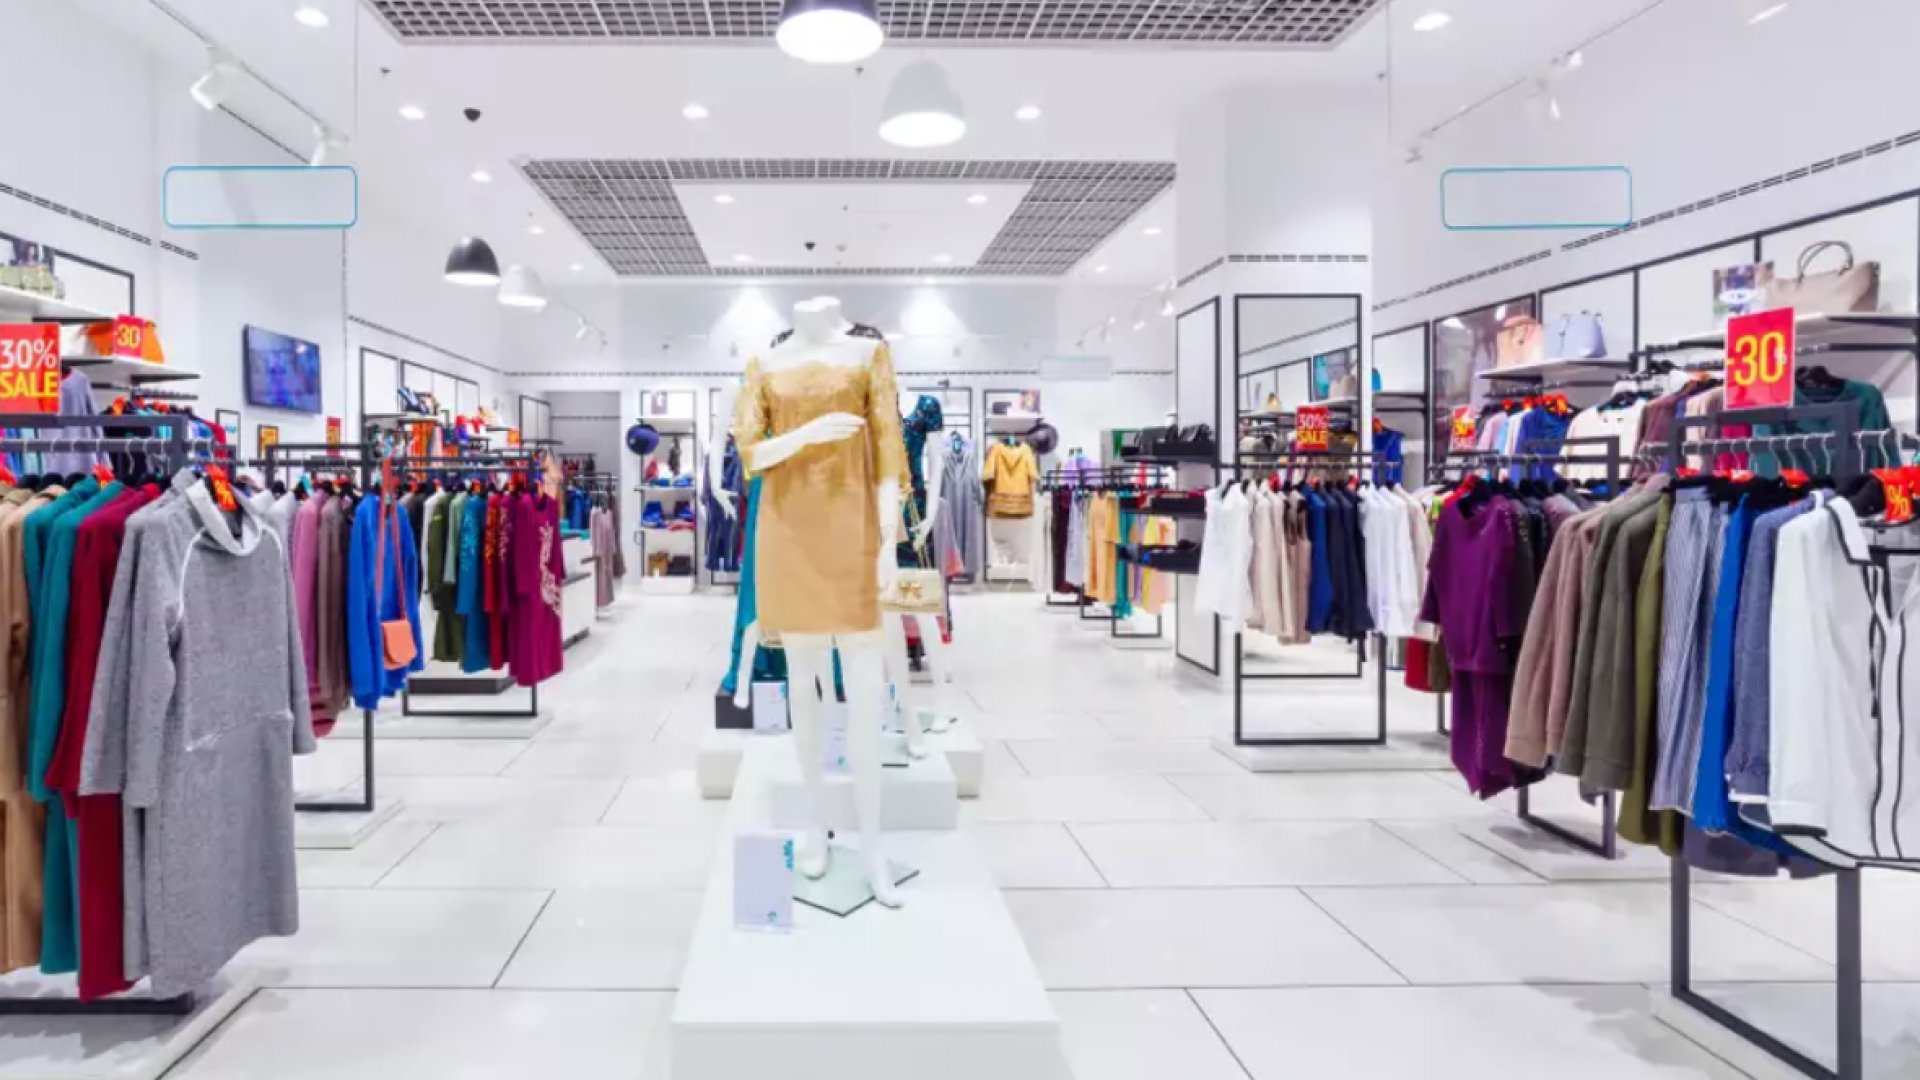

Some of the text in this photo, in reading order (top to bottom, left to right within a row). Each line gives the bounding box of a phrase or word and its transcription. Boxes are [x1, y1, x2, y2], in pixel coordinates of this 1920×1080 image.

[0, 338, 57, 369] 30%
[0, 371, 58, 398] SALE
[1297, 430, 1328, 443] SALE
